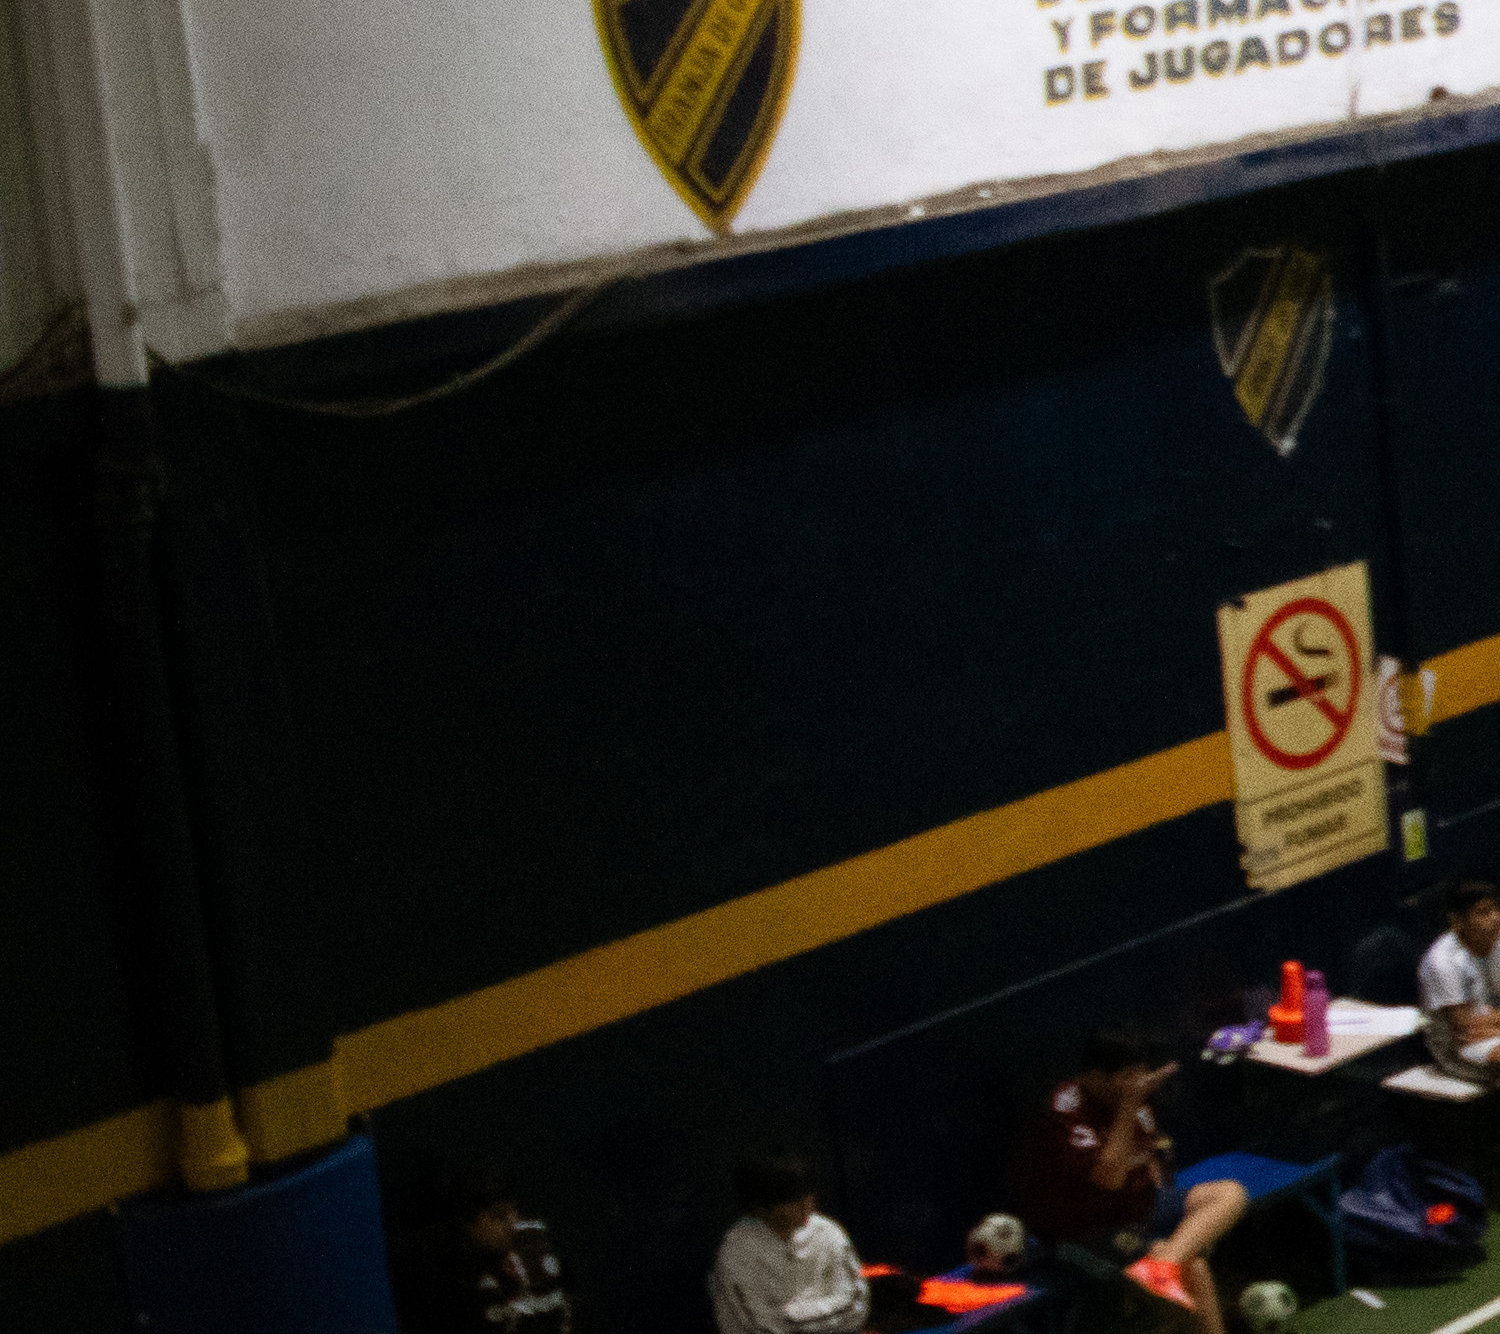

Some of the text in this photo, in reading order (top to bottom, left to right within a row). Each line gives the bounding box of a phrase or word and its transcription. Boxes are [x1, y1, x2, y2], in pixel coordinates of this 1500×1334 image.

[1043, 0, 1463, 107] DE JUGADORES
[1050, 17, 1073, 54] Y
